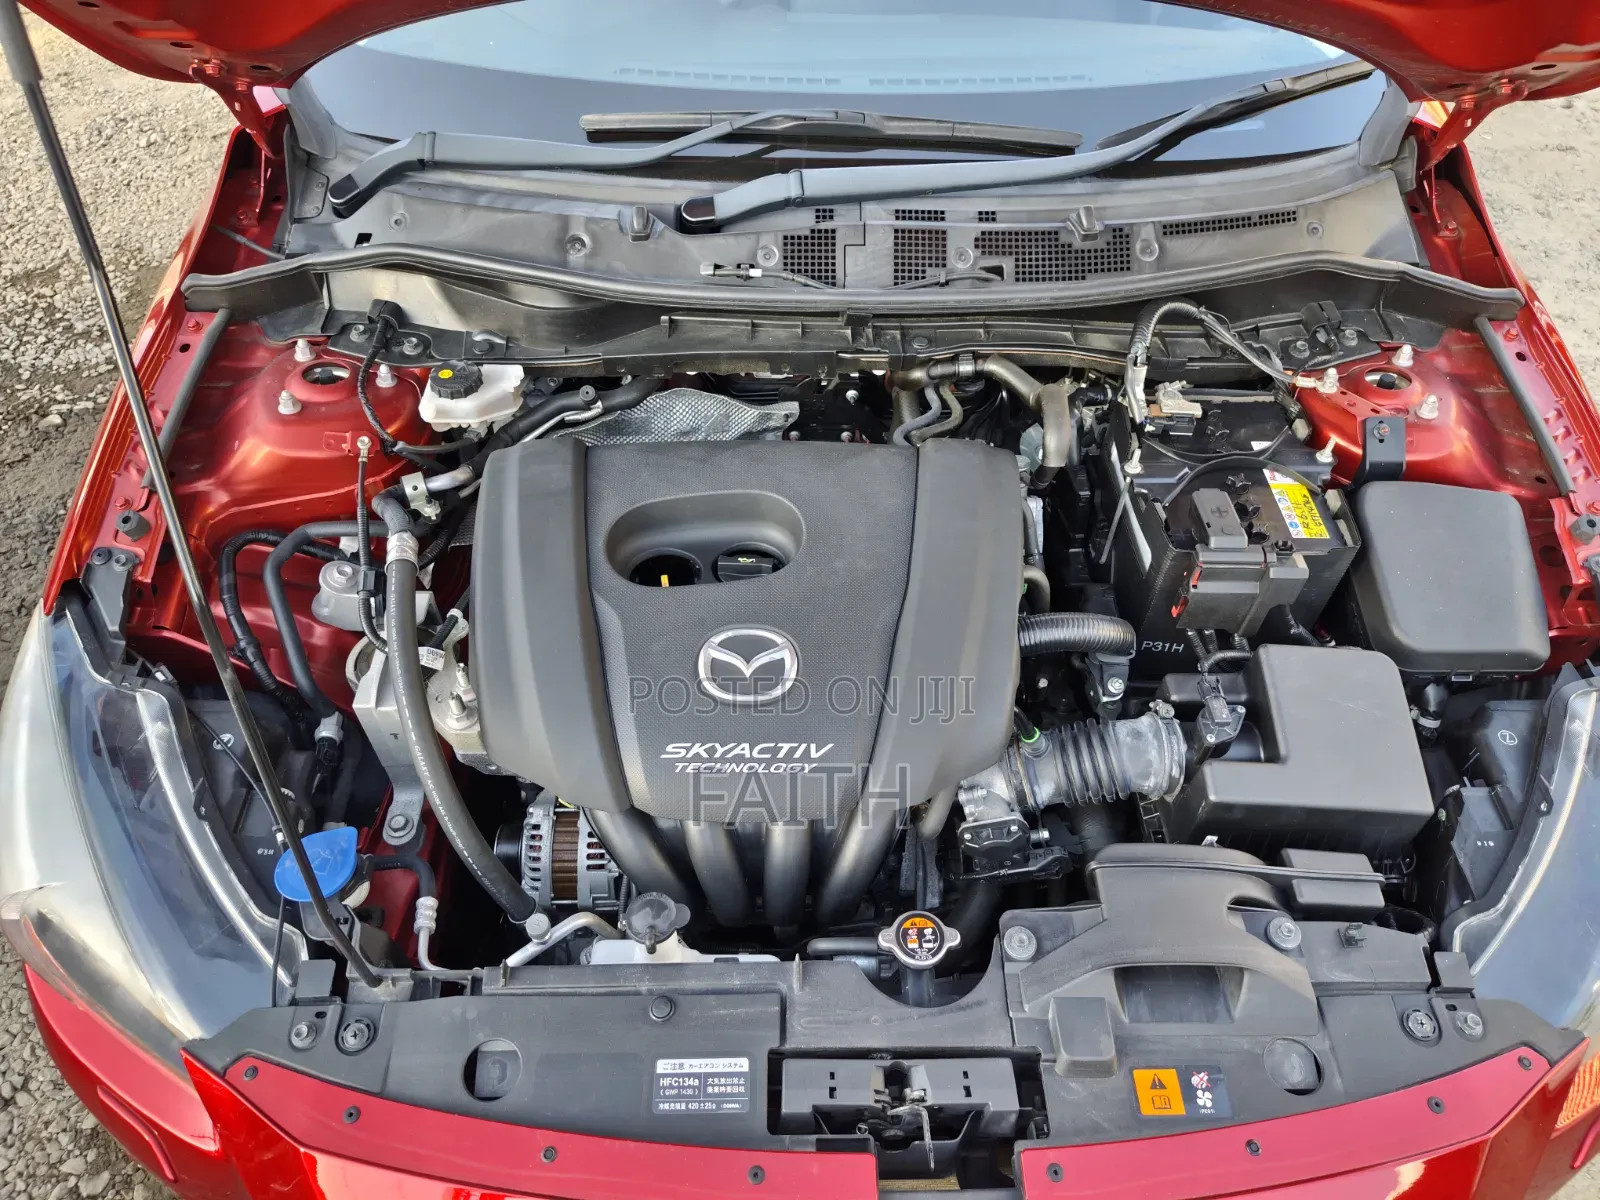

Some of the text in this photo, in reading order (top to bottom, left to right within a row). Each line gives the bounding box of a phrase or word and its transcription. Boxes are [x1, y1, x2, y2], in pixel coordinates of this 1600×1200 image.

[1141, 640, 1184, 652] P31H
[660, 742, 834, 758] SKYACTIV
[415, 746, 430, 776] GALAXY
[674, 762, 818, 773] TECHNOLOGY
[663, 1062, 685, 1070] ご注意
[660, 1077, 699, 1086] HFC134a
